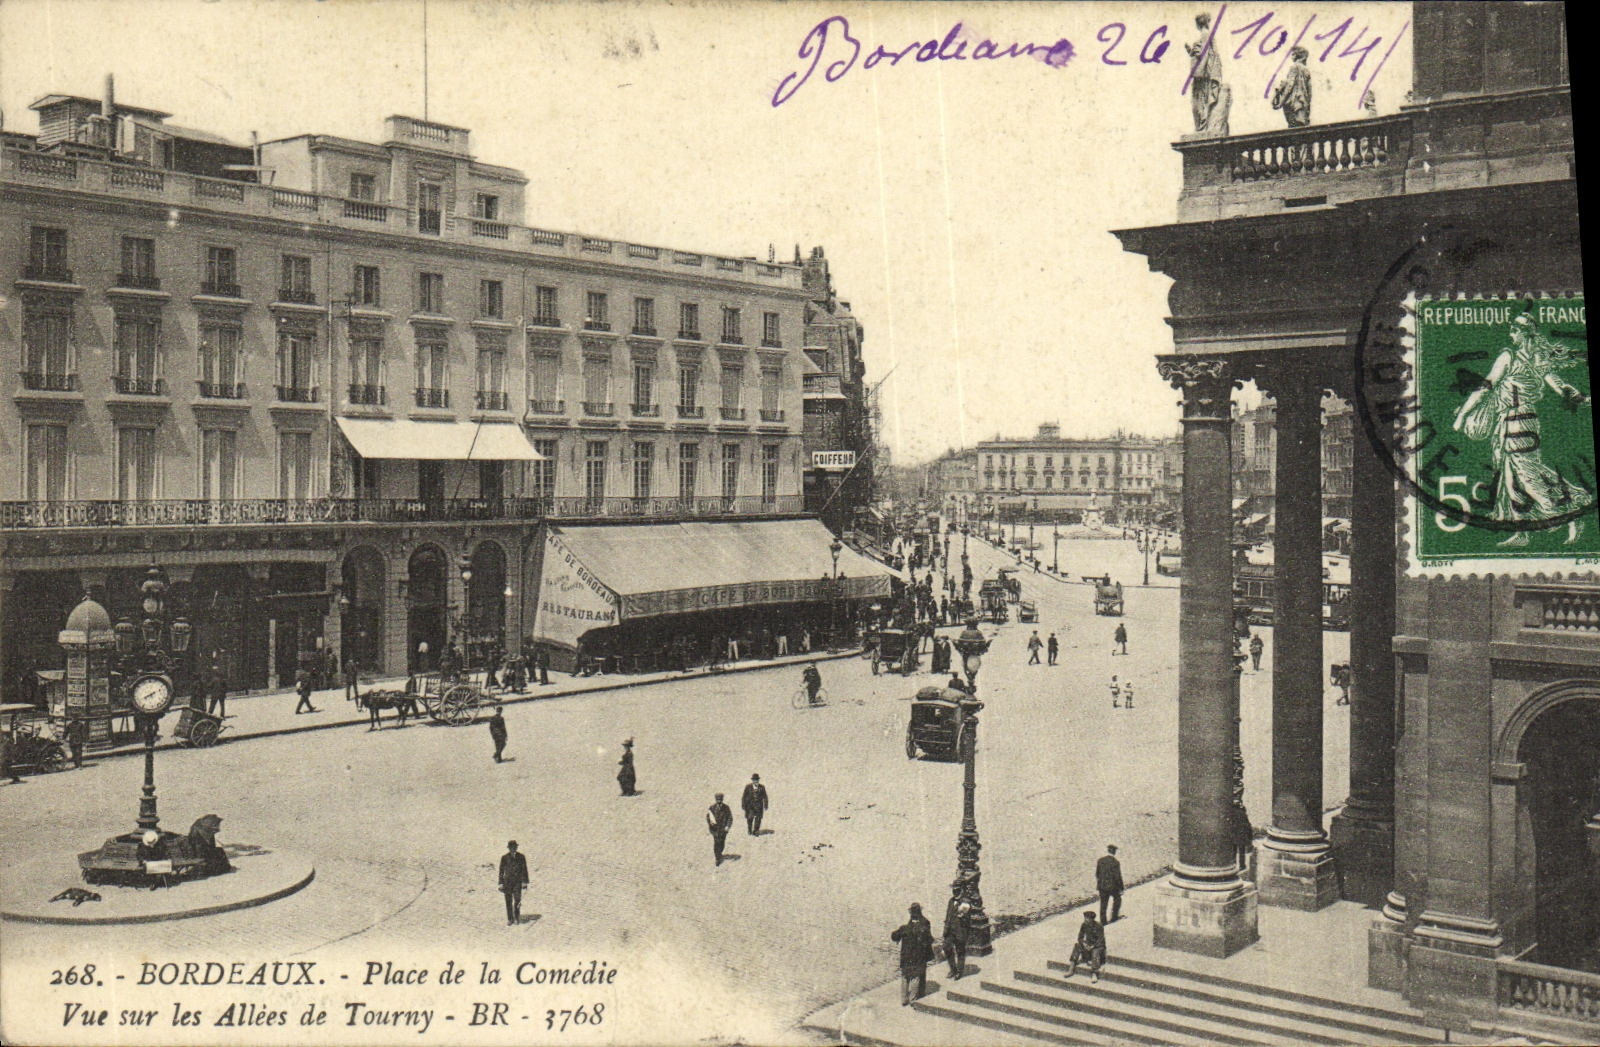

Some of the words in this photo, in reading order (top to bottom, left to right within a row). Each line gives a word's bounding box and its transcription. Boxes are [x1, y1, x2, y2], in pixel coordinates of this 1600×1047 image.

[1424, 306, 1511, 326] REPUBLIQUE
[813, 453, 854, 465] COIFFEUR
[565, 553, 576, 568] DE
